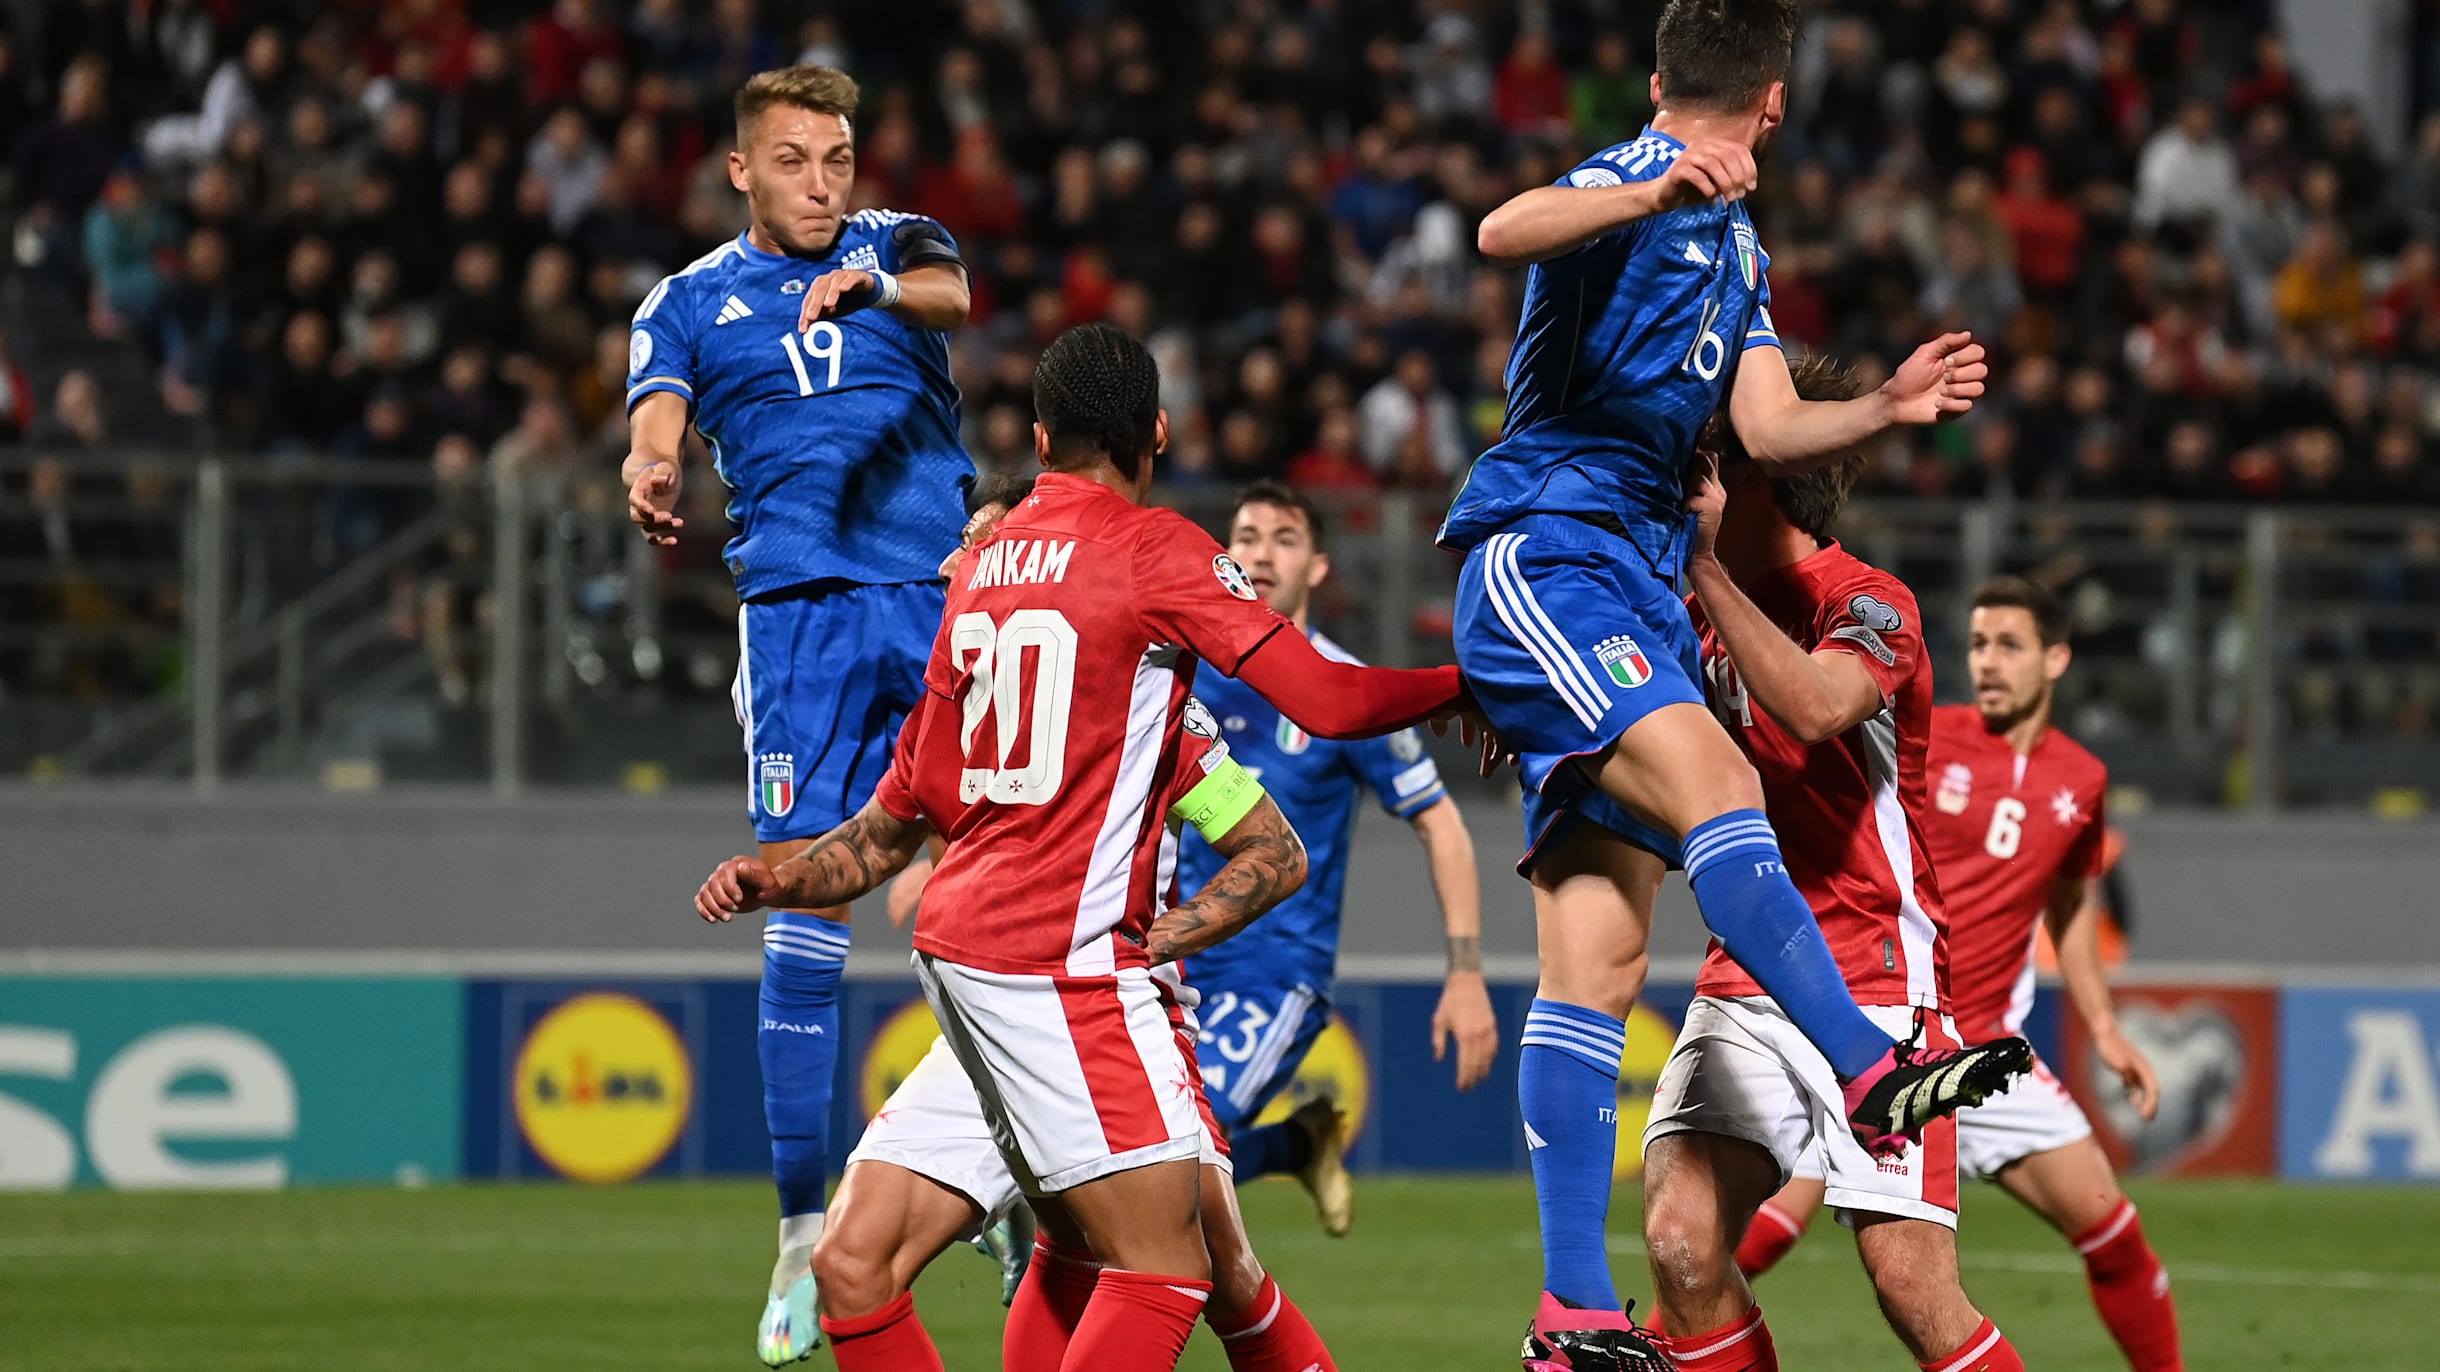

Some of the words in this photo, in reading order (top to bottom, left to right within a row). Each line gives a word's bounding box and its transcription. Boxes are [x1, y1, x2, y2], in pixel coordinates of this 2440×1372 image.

[780, 321, 843, 397] 19
[1603, 643, 1637, 662] ITALIA
[951, 609, 1078, 805] 20
[763, 766, 790, 778] ITALIA
[1985, 797, 2027, 860] 6
[763, 1018, 824, 1035] ITALIA
